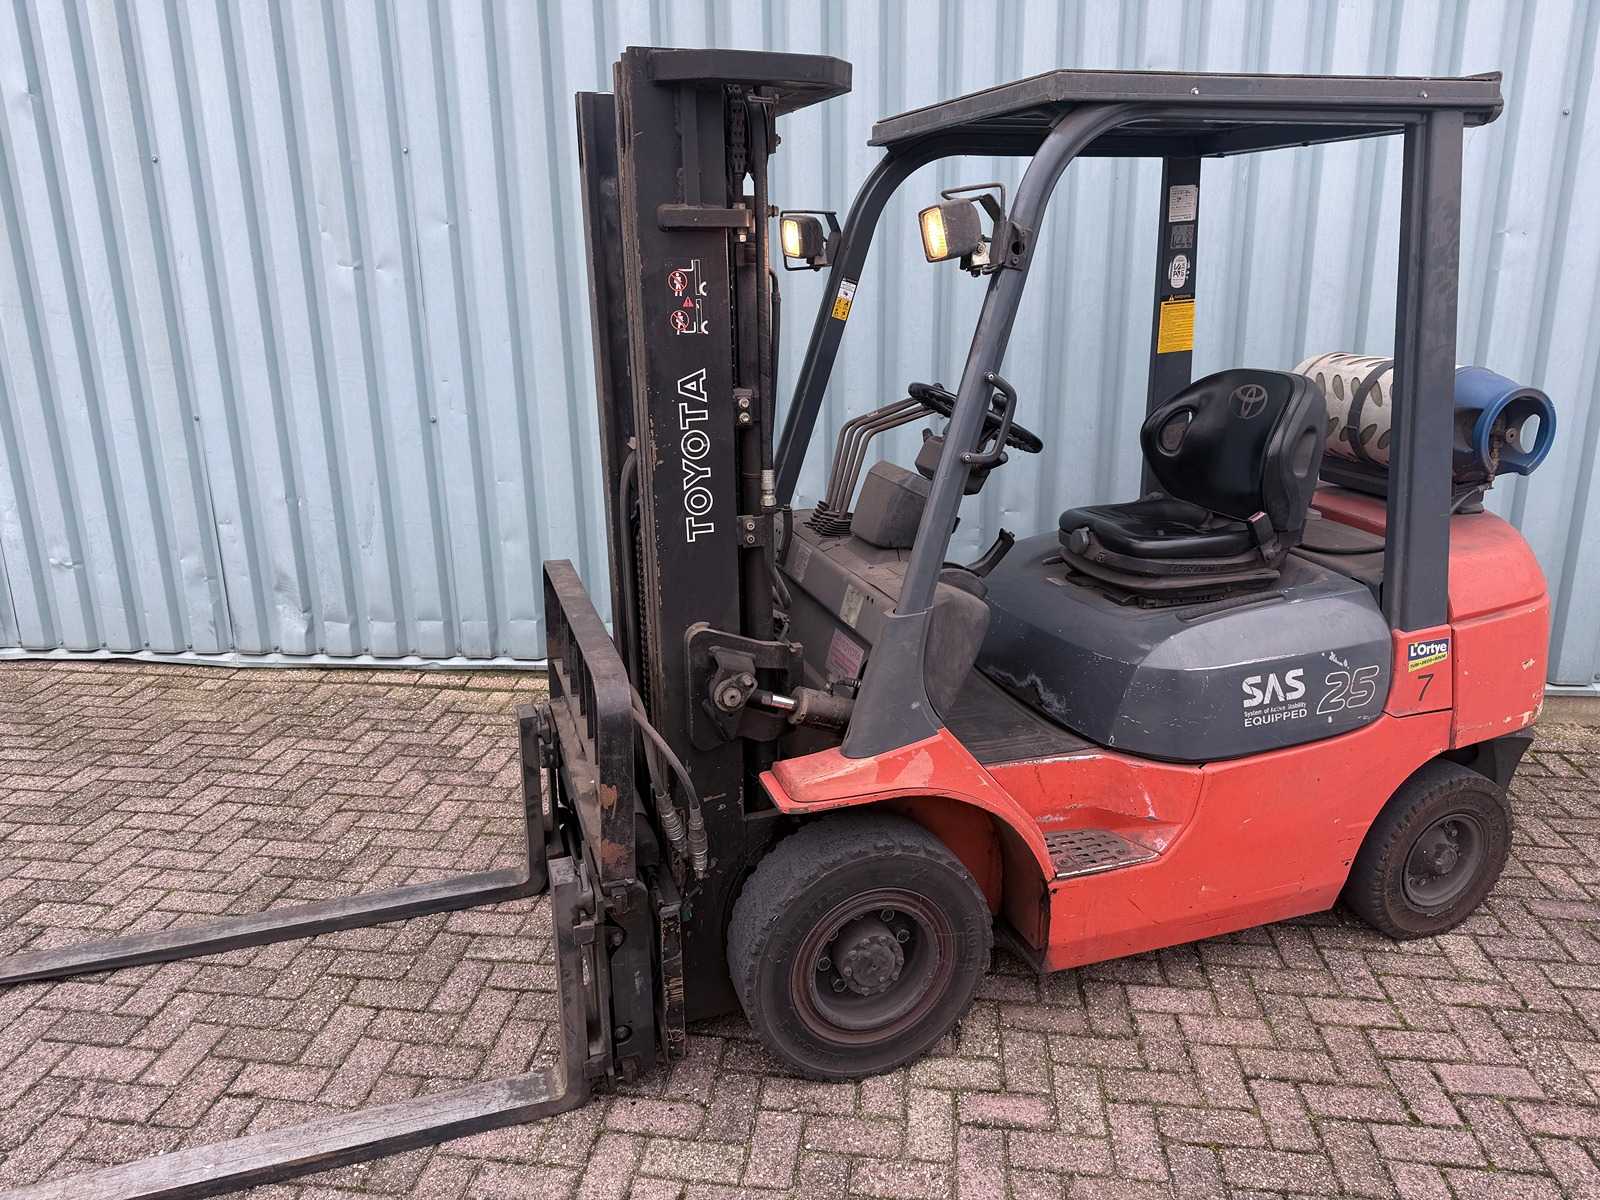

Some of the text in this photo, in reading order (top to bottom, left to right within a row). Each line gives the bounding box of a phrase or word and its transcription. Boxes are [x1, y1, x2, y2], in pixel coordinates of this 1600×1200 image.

[678, 368, 714, 542] TOYOTA
[1410, 642, 1447, 657] L'Ortye
[1242, 668, 1306, 708] SAS
[1316, 665, 1379, 715] 25
[1417, 673, 1434, 702] 7
[1243, 709, 1262, 718] System
[1244, 709, 1307, 727] EQUIPPED
